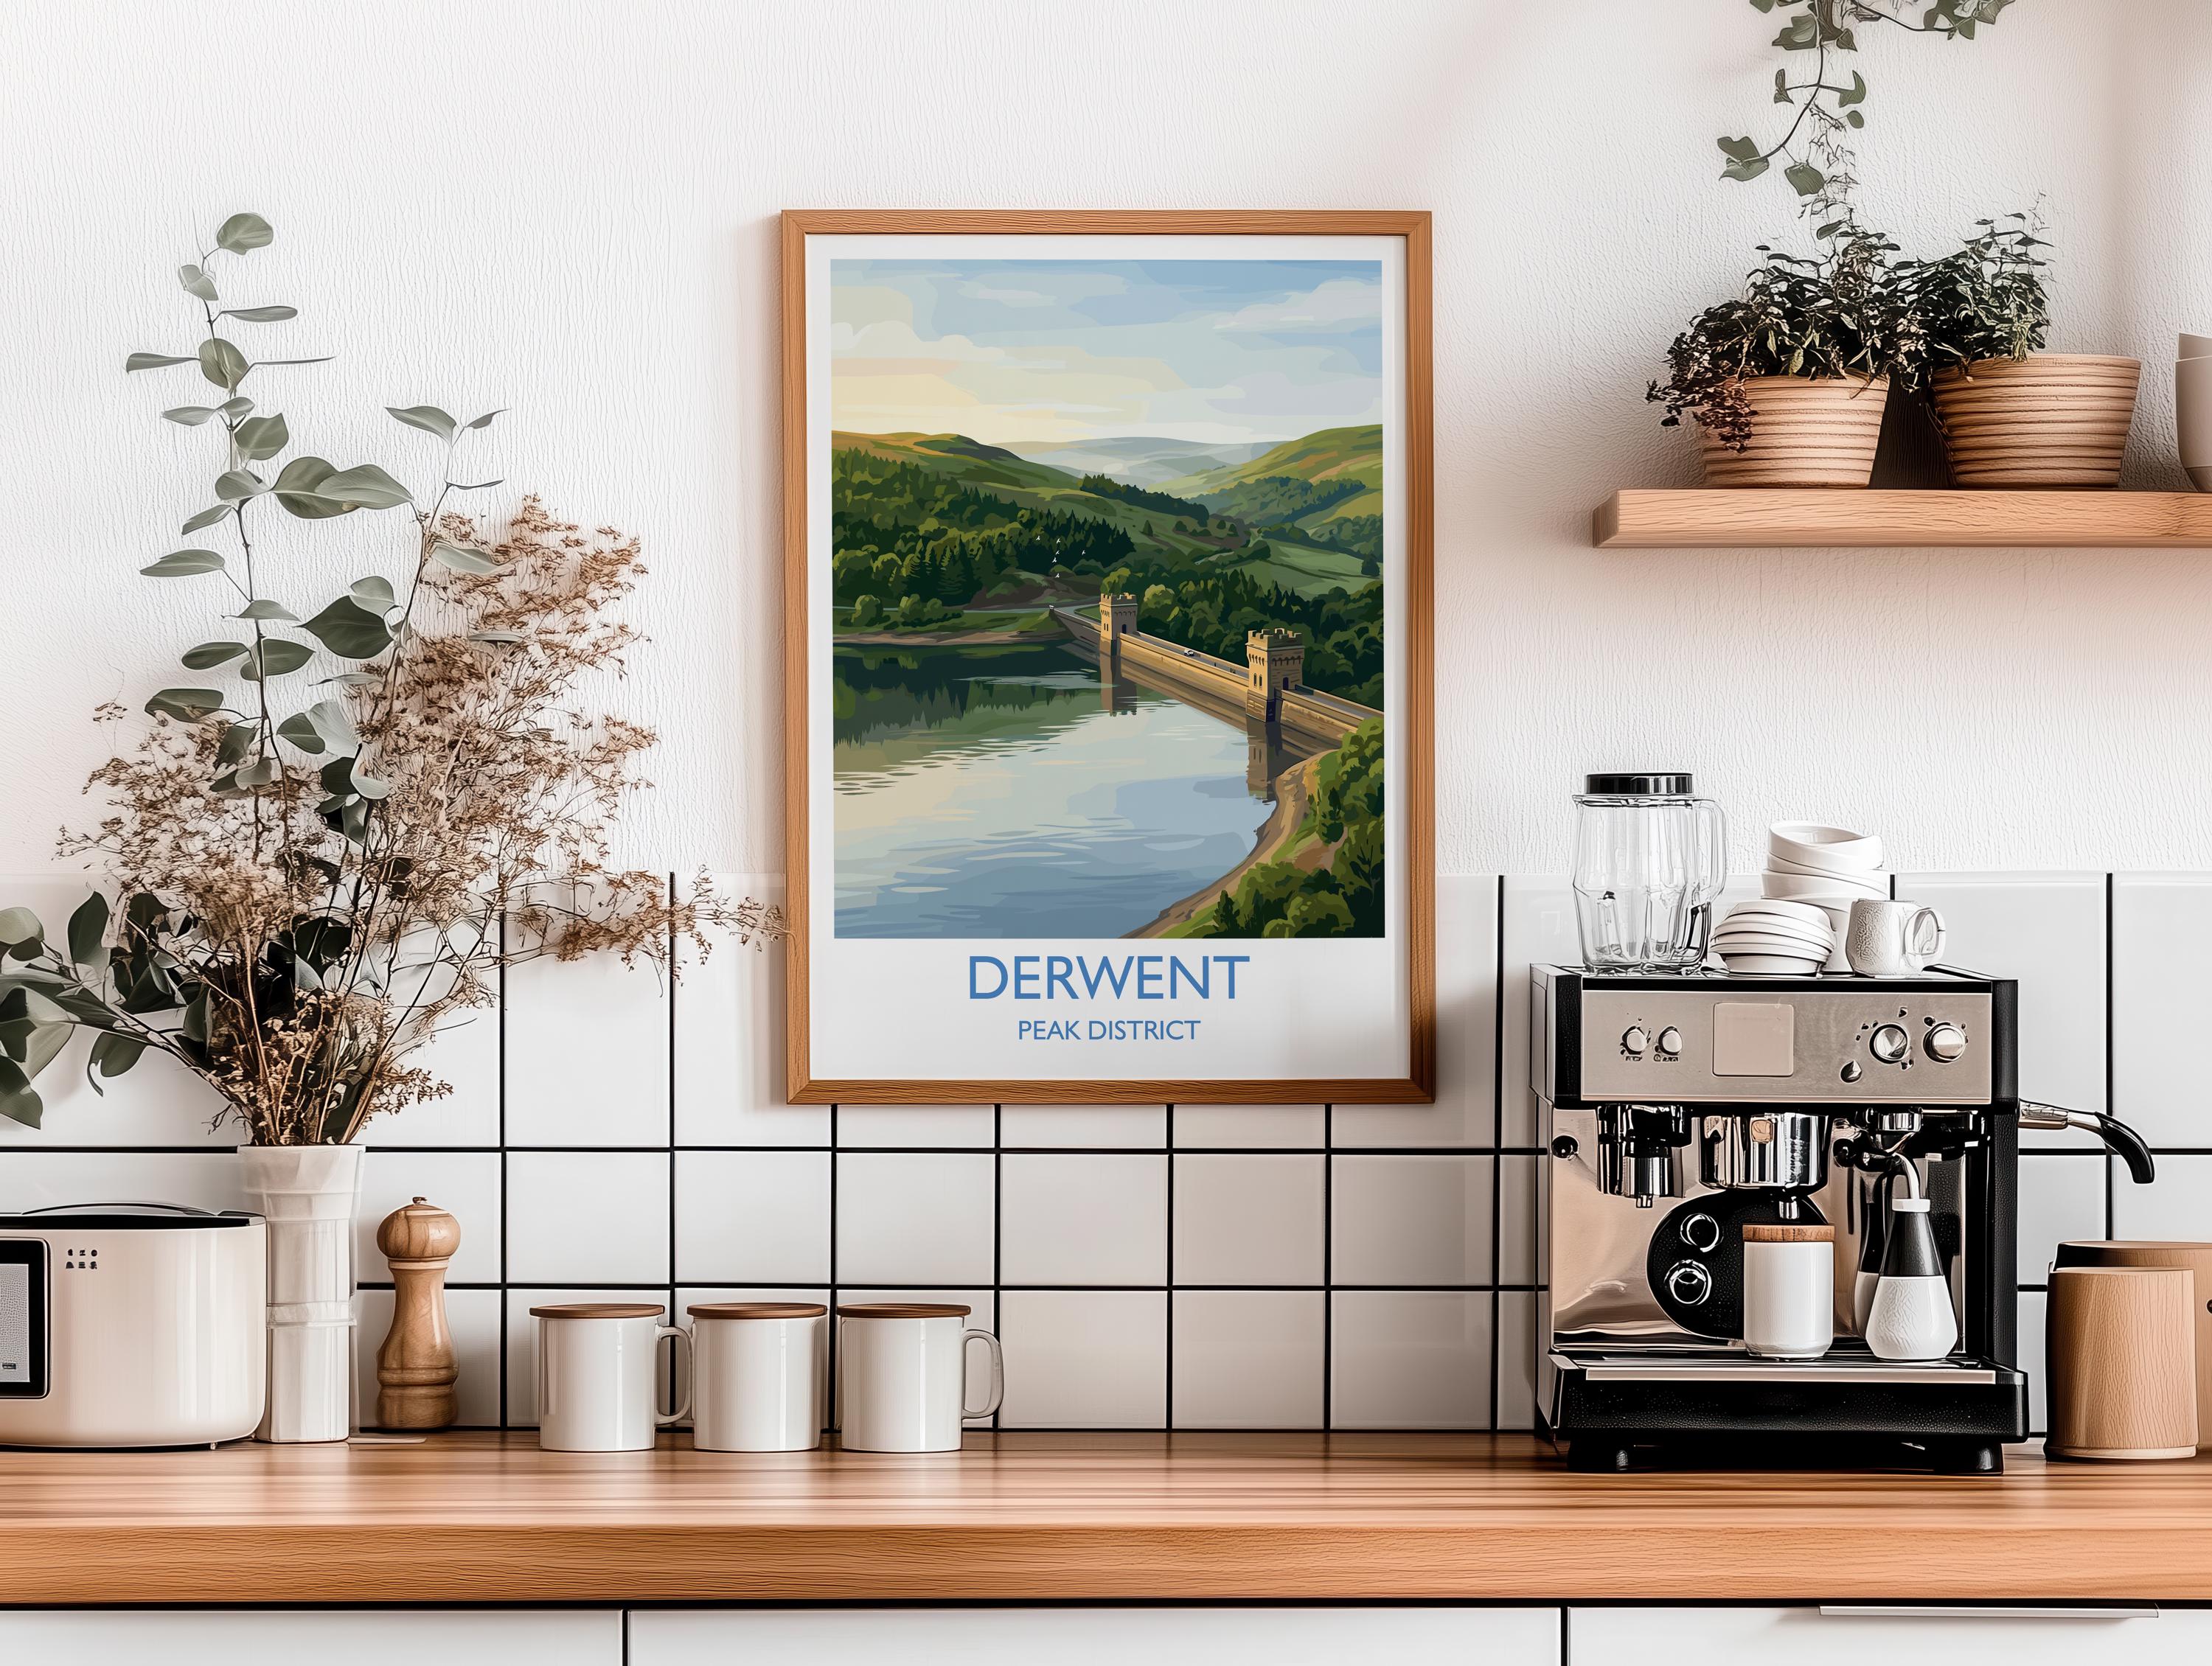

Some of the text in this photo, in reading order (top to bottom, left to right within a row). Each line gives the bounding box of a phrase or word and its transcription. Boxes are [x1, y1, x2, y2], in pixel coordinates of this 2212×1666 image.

[969, 955, 1251, 1000] DERWENT
[1018, 1020, 1201, 1040] PEAK DISTRICT
